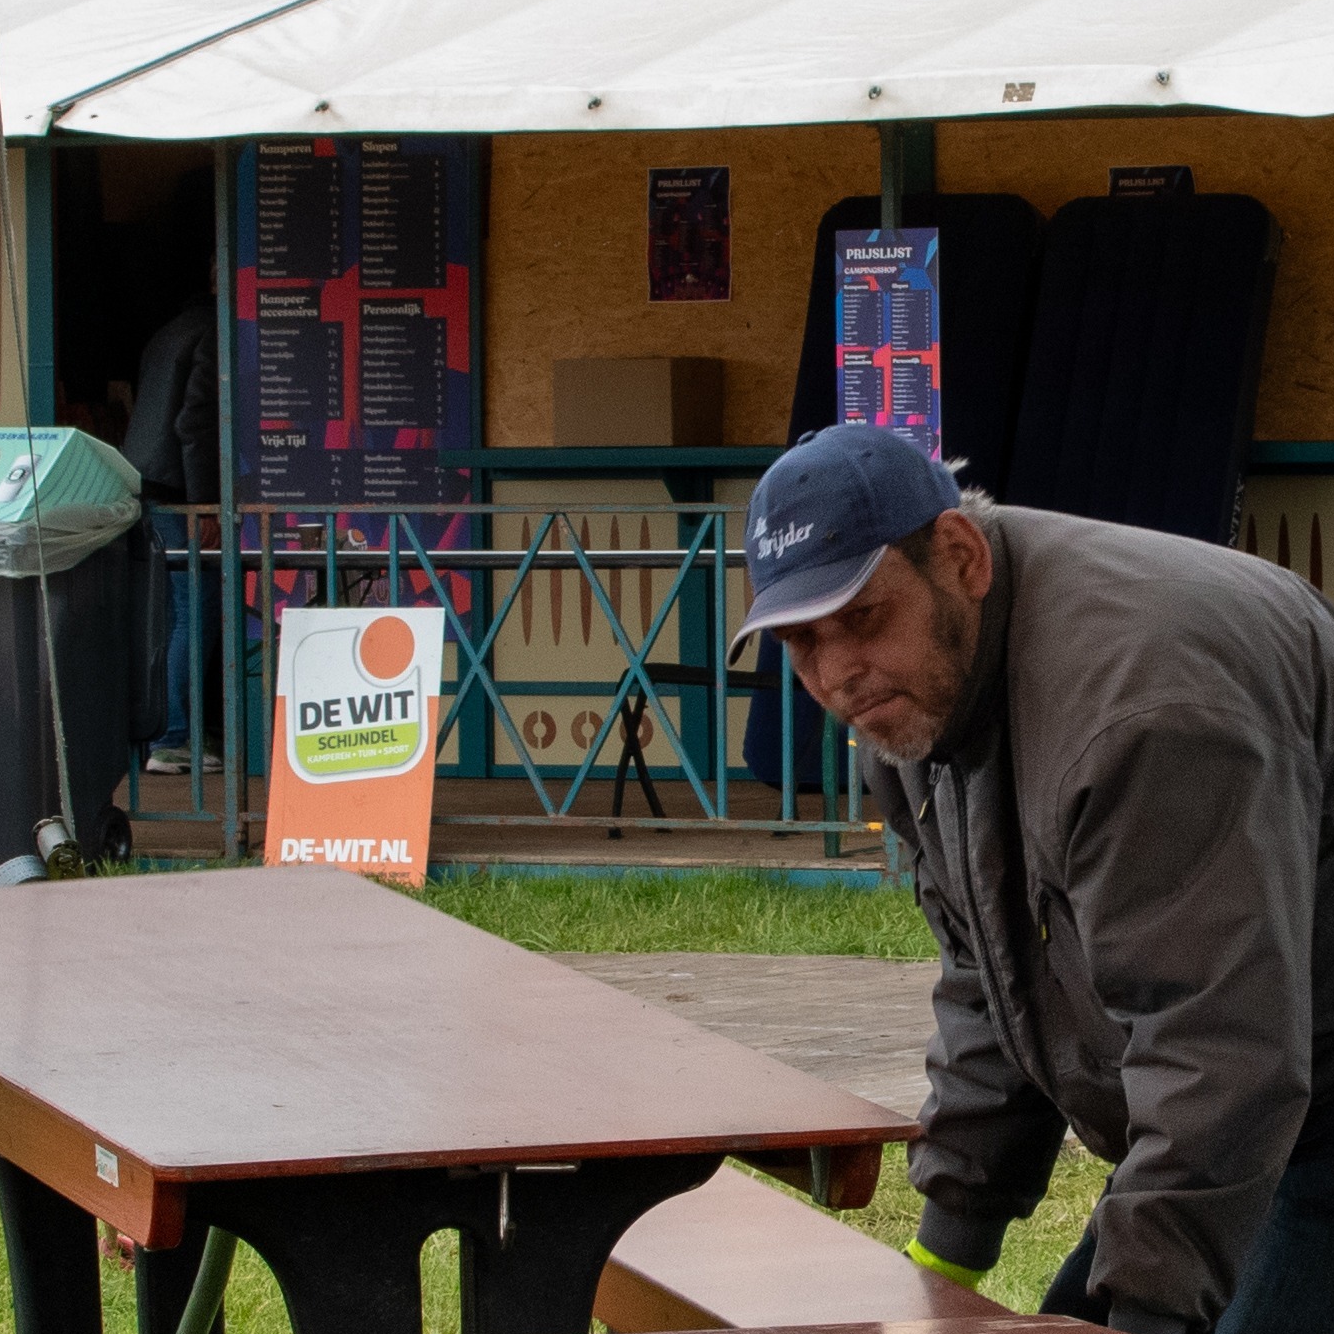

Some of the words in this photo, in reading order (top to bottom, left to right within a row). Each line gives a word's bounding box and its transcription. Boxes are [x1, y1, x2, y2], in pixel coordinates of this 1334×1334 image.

[846, 247, 913, 260] PRIJSLIJST
[300, 698, 341, 731] DE
[347, 690, 415, 725] WIT
[318, 729, 398, 750] SCHIJNDEL
[306, 751, 351, 764] KAMPEREN
[358, 748, 377, 759] TUIN
[383, 744, 410, 756] SPORT
[280, 838, 412, 863] DE-WIT.NL
